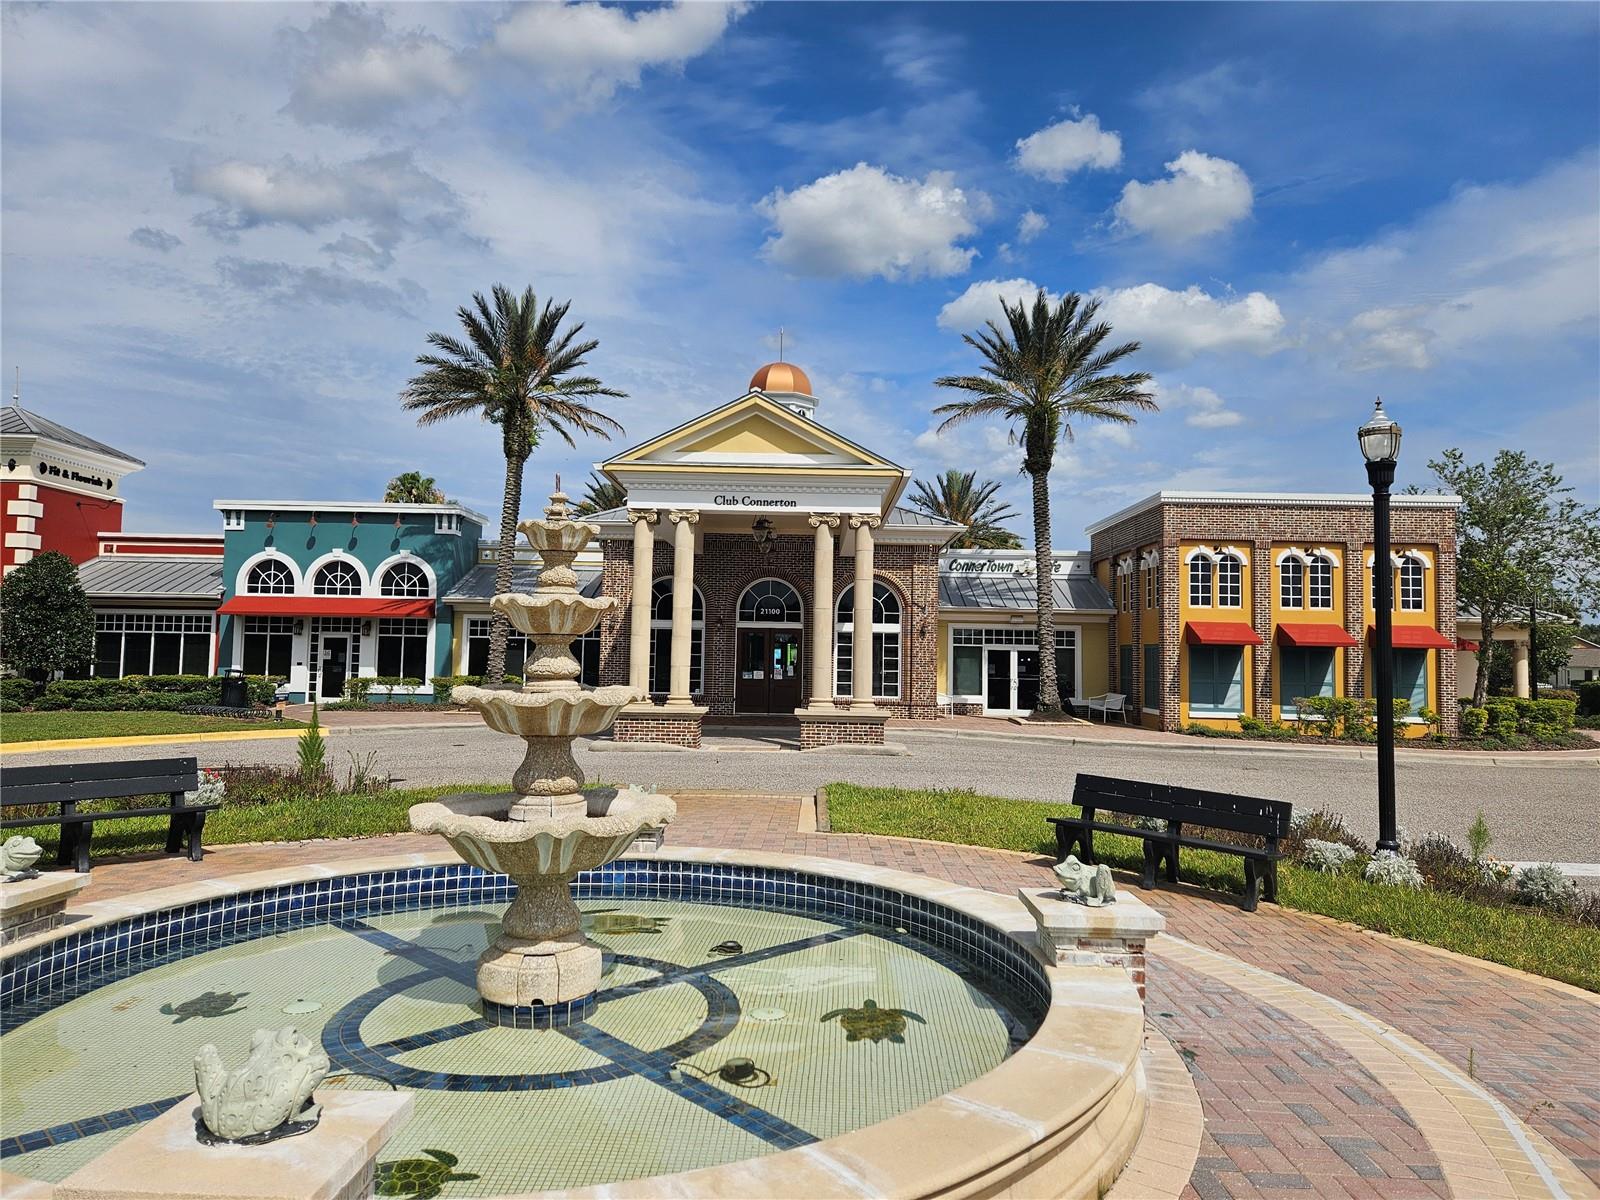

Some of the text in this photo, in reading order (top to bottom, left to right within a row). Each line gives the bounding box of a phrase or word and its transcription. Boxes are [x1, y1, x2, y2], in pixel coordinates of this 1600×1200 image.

[49, 466, 61, 477] Fit
[62, 470, 70, 480] &
[714, 496, 797, 507] Club Connerton
